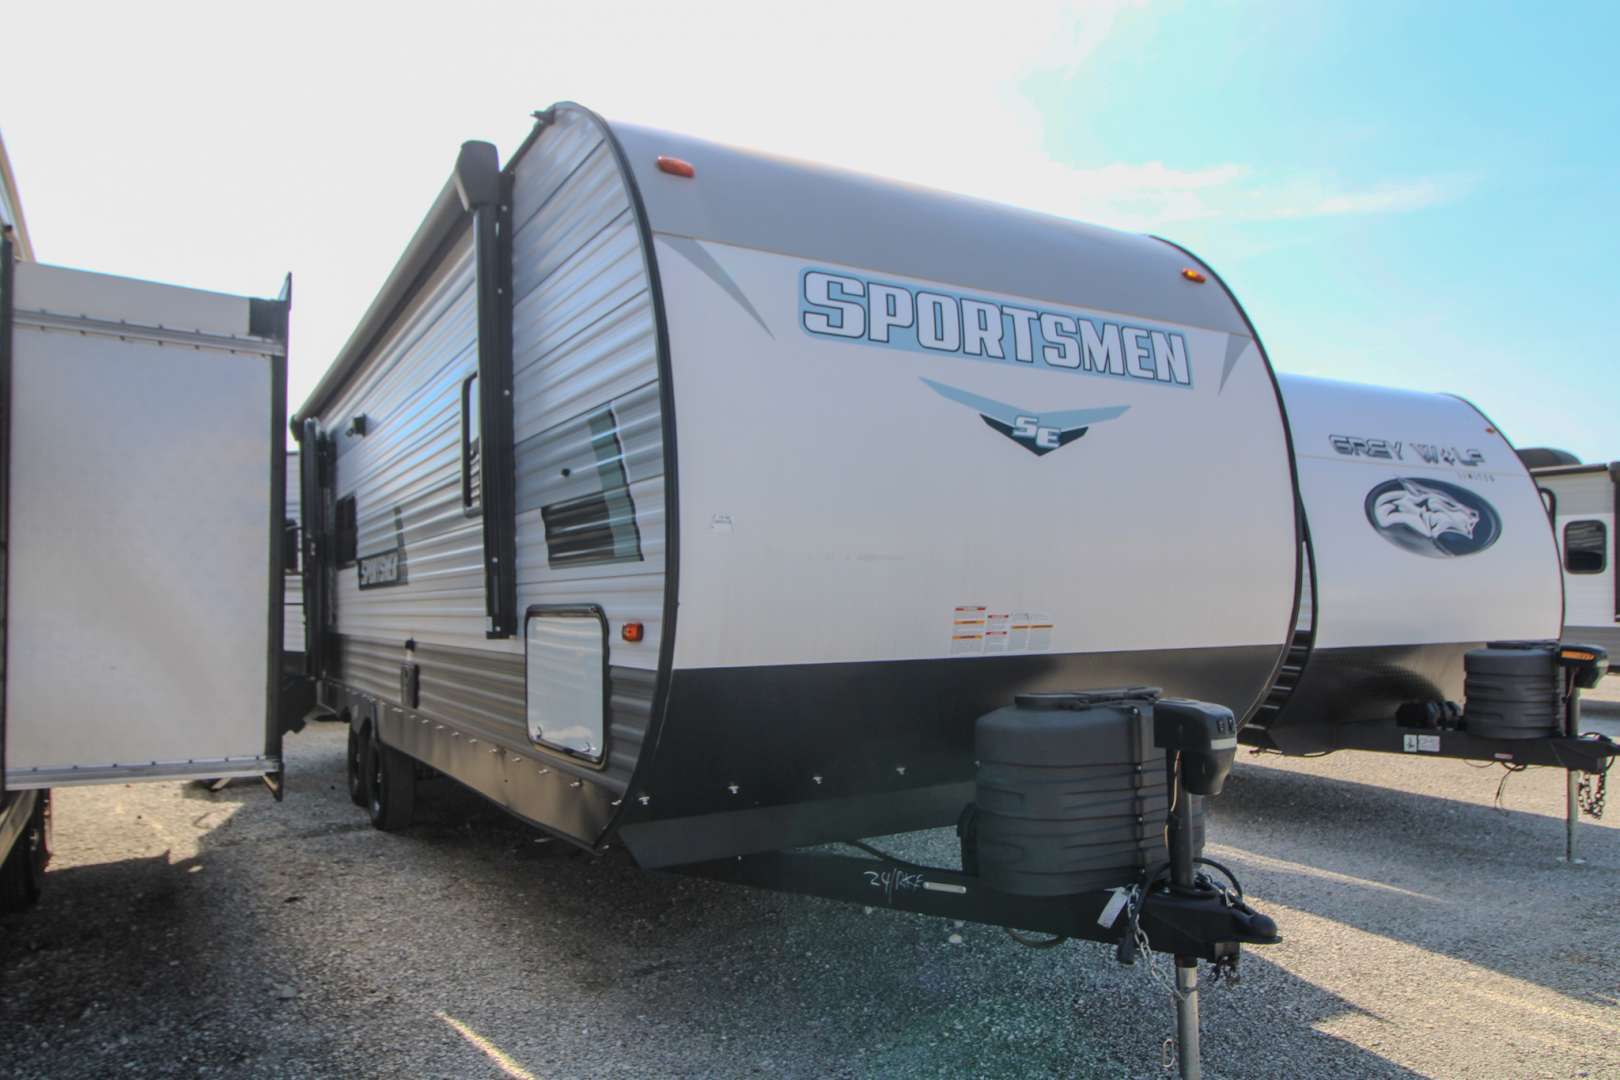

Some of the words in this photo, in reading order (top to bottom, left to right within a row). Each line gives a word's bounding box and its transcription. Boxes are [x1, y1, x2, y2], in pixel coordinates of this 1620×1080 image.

[803, 271, 1191, 385] SPORTSMEN
[1012, 415, 1061, 448] SE
[1329, 434, 1404, 461] GREY
[1409, 442, 1485, 467] WOLF
